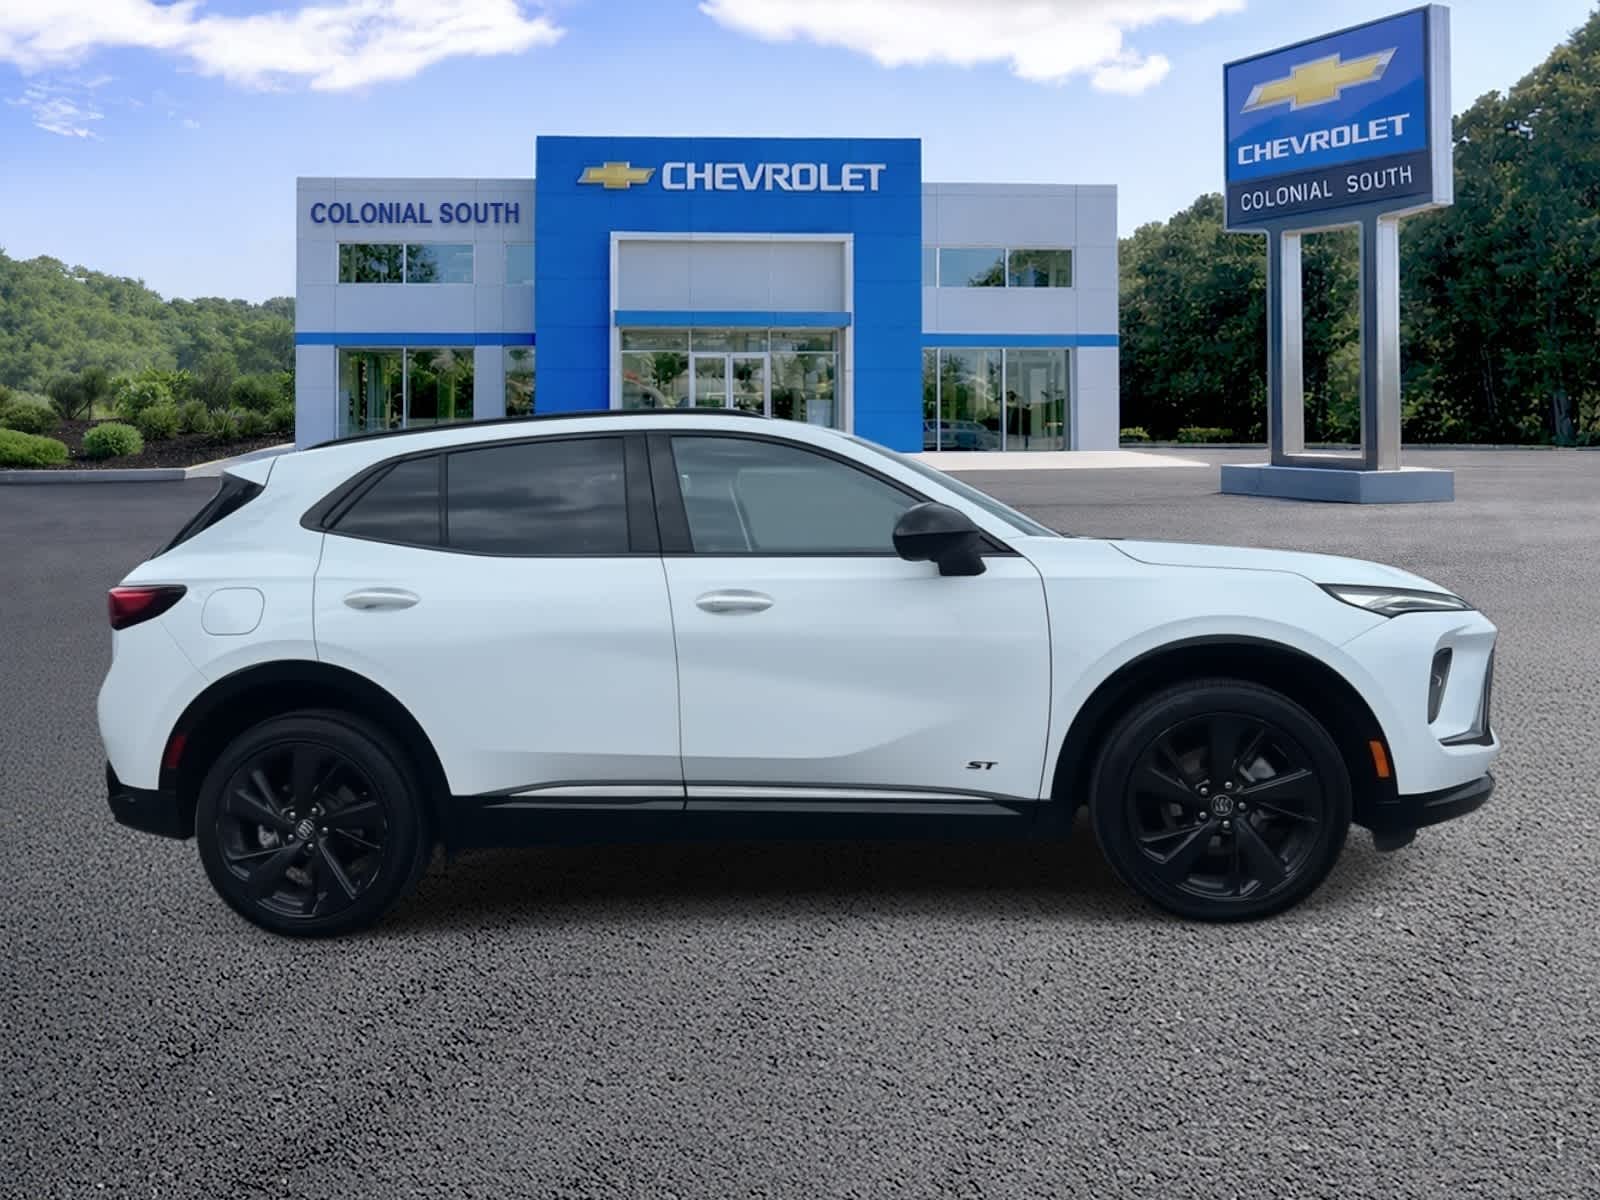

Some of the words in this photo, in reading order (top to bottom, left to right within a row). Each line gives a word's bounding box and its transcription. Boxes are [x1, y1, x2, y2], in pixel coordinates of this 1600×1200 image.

[1238, 113, 1410, 165] CHEVROLET
[662, 162, 886, 192] CHEVROLET
[1240, 179, 1333, 212] COLONIAL
[1346, 165, 1413, 193] SOUTH
[310, 202, 432, 225] COLONIAL
[439, 202, 520, 225] SOUTH
[965, 760, 999, 770] ST
